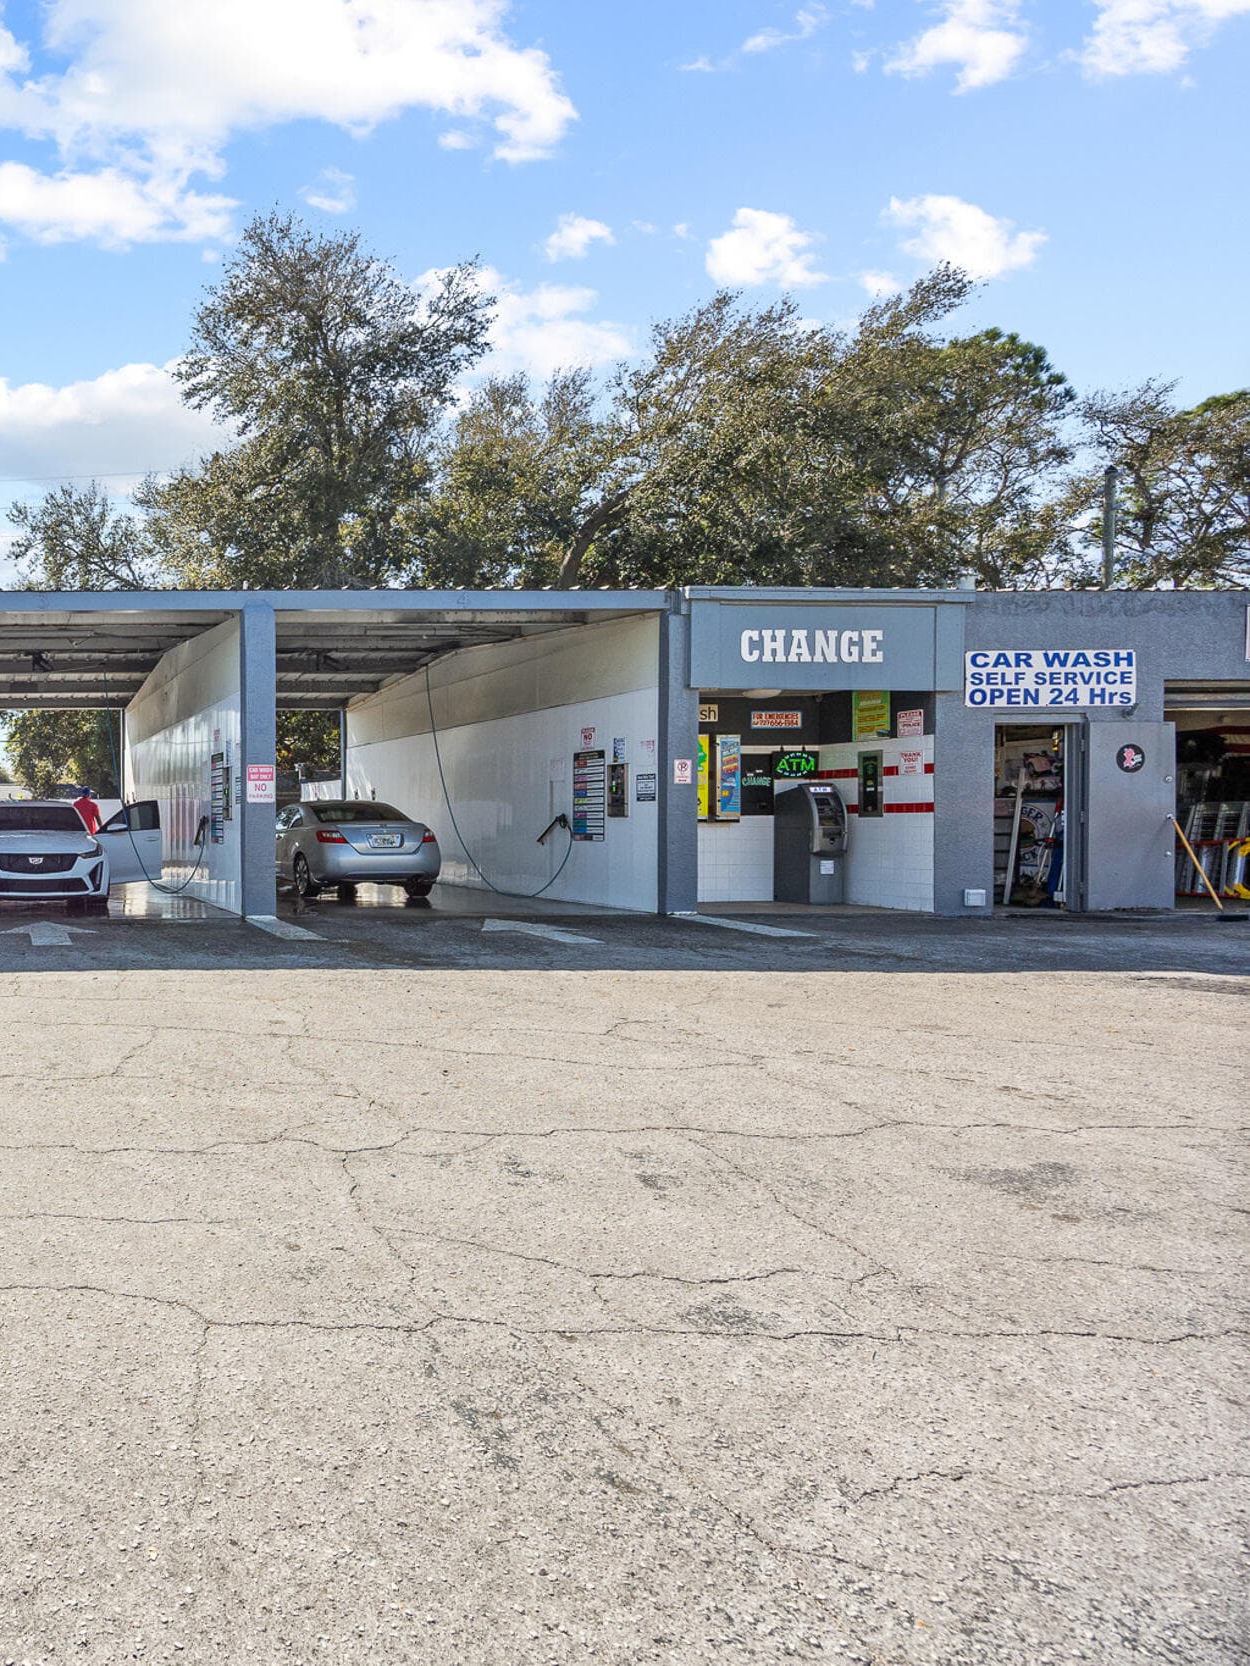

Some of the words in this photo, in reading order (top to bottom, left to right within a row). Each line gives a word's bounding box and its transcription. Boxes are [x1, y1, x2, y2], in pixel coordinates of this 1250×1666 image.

[740, 629, 884, 664] CHANGE
[970, 652, 1032, 668] CAR
[1044, 651, 1134, 668] WASH
[970, 672, 1025, 686] SELF
[1034, 671, 1133, 686] SERVICE
[969, 688, 1040, 706] OPEN
[1049, 687, 1080, 705] 24
[1088, 687, 1132, 705] Hrs
[700, 707, 716, 721] sh
[776, 758, 815, 772] ATM
[254, 783, 267, 792] NO
